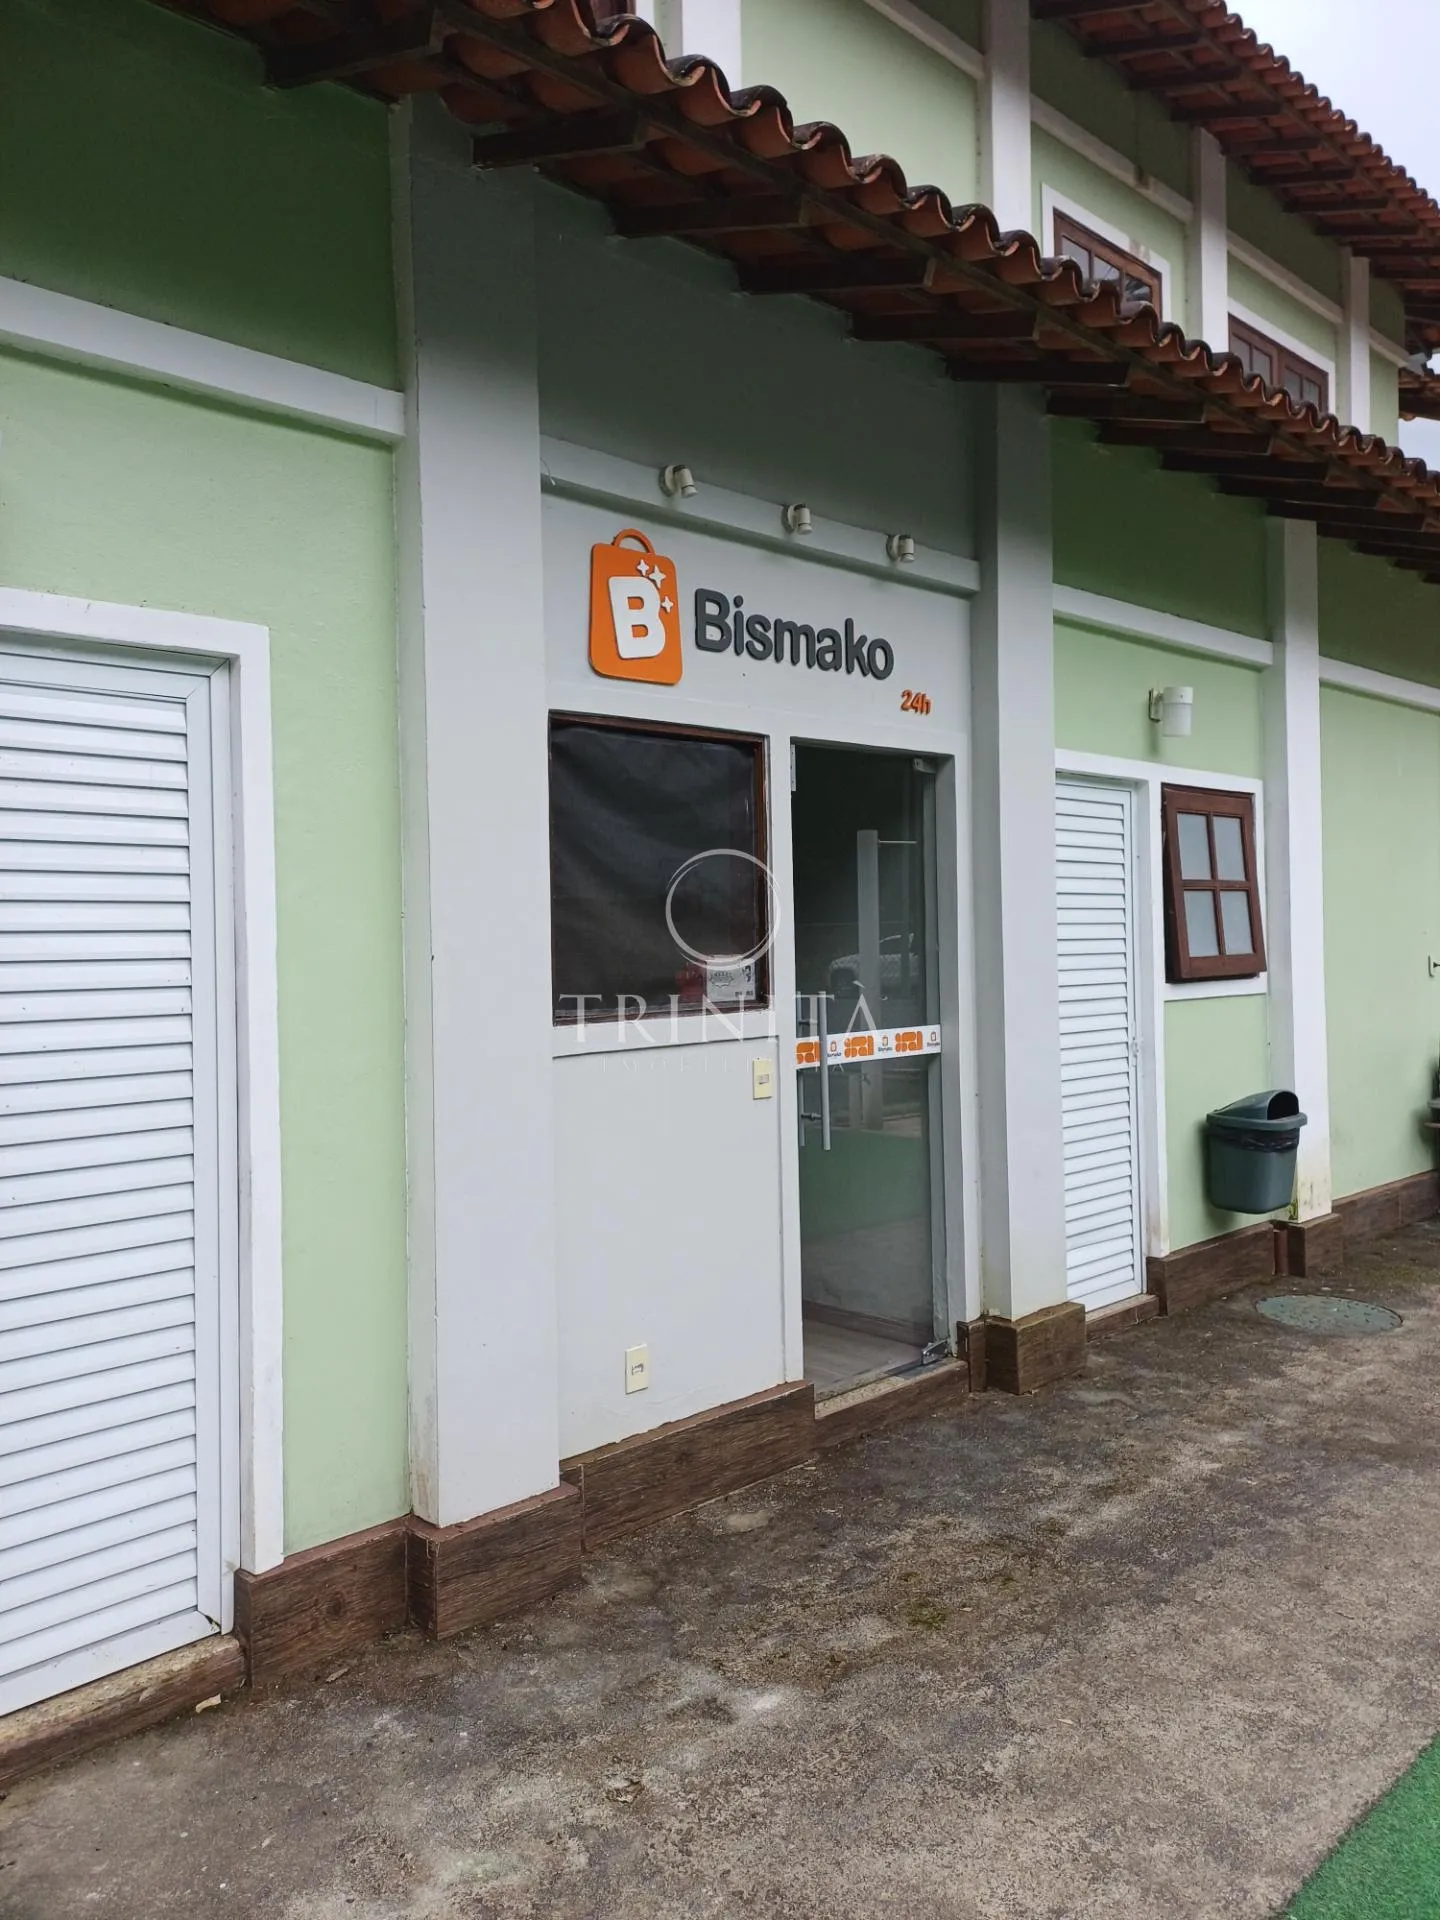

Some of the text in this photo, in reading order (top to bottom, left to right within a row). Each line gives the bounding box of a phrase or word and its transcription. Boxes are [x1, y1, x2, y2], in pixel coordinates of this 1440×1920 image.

[608, 576, 665, 660] B
[694, 588, 895, 680] Bismako
[900, 689, 932, 715] 24h
